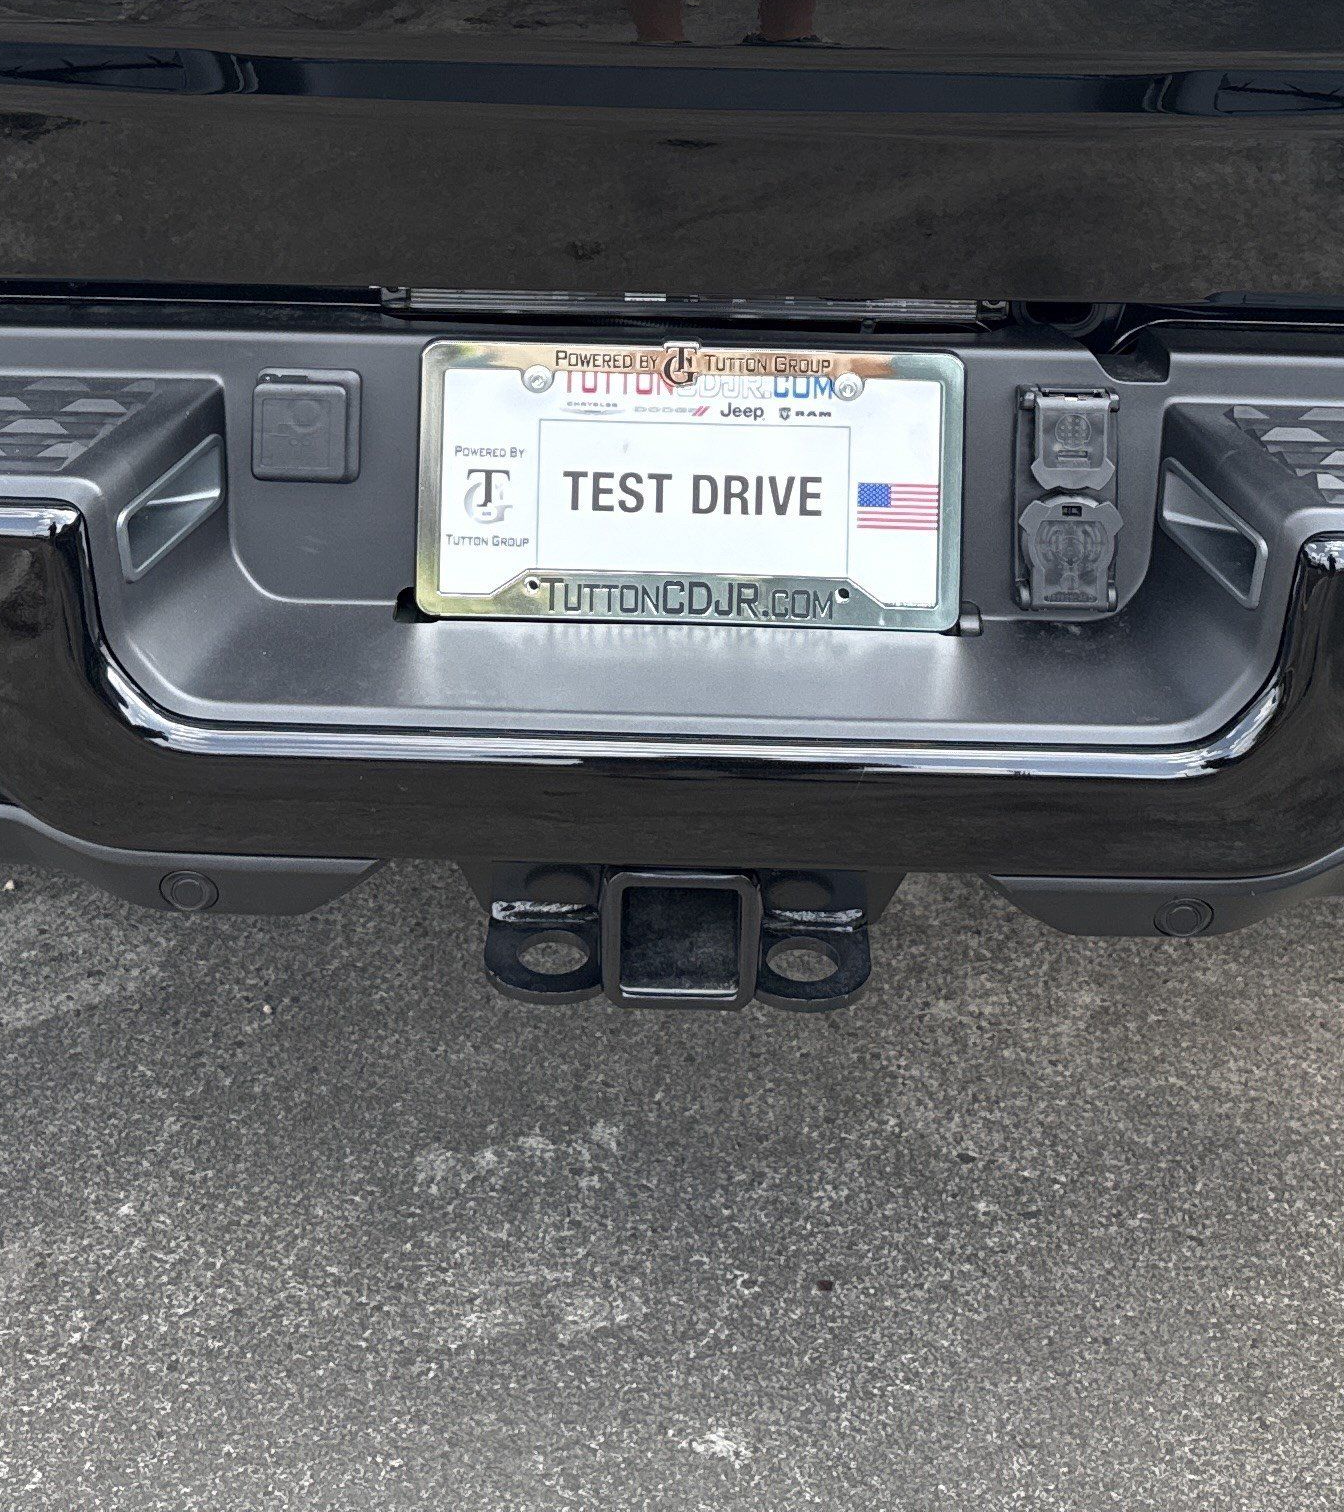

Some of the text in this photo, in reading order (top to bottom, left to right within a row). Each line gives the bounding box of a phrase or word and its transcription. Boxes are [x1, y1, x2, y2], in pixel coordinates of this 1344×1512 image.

[556, 350, 632, 369] POWERED
[705, 354, 831, 374] TUTTON GROUP
[720, 402, 764, 421] Jeep
[795, 410, 832, 418] RAM
[562, 470, 823, 517] TEST DRIVE
